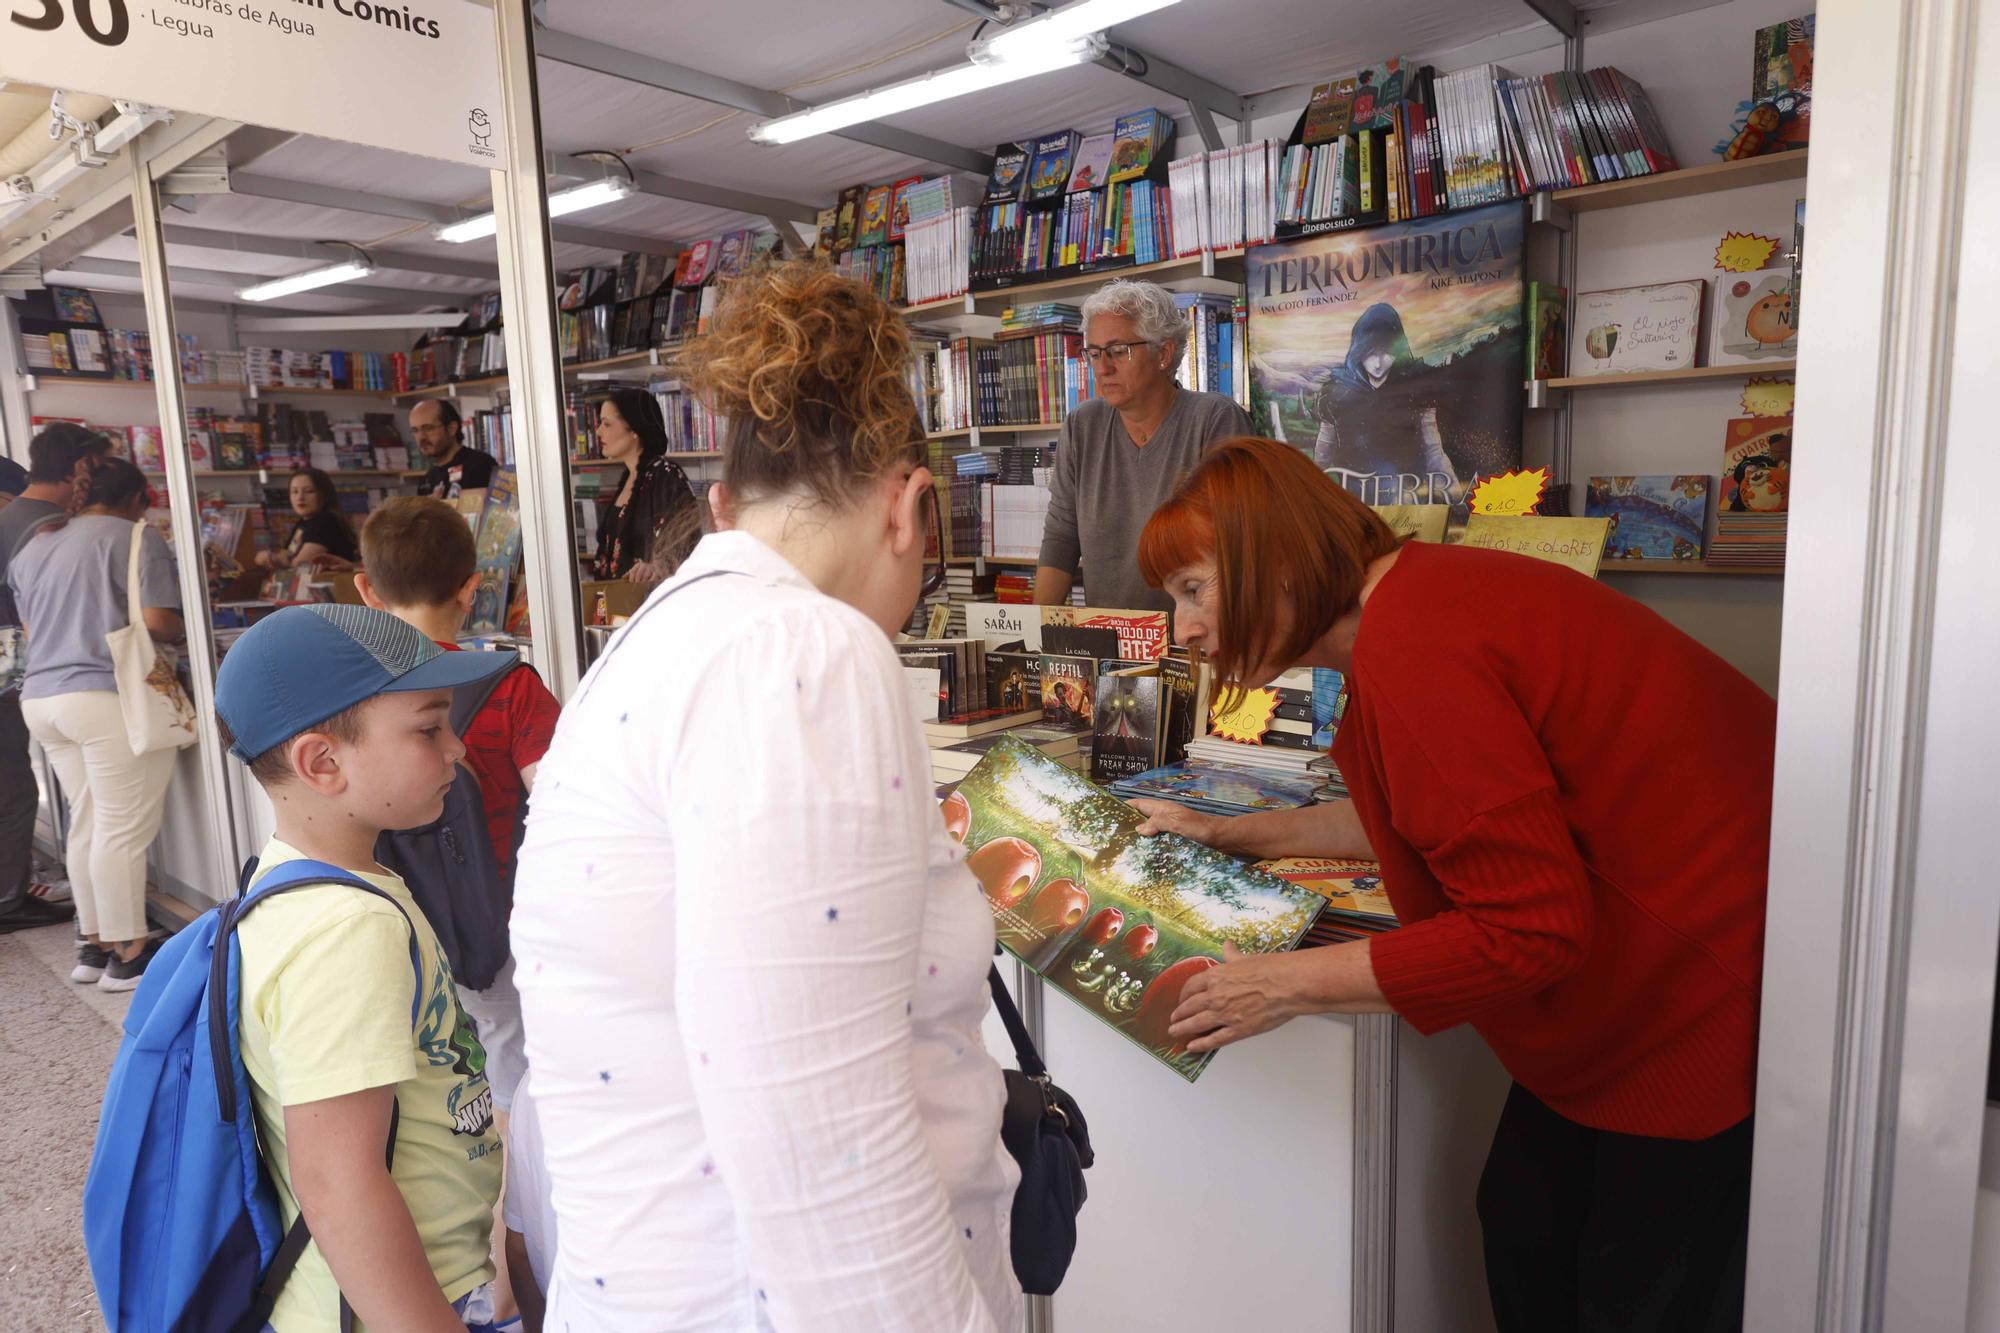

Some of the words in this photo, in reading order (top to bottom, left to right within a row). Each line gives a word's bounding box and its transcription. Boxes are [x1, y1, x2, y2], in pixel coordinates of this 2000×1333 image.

[152, 8, 214, 38] Legua
[238, 5, 262, 23] de
[268, 11, 315, 36] Agua
[1311, 218, 1355, 232] DEBOLSILLO
[1431, 276, 1452, 290] KIKE
[1278, 299, 1303, 312] COTO
[1732, 436, 1772, 463] CUATR
[1517, 541, 1528, 552] DE
[1536, 538, 1594, 557] COLORES
[984, 619, 1022, 631] SARAH
[1146, 629, 1161, 641] DE
[1049, 662, 1083, 678] REPTIL
[1098, 759, 1123, 771] FREAK
[1126, 761, 1149, 773] SHOW
